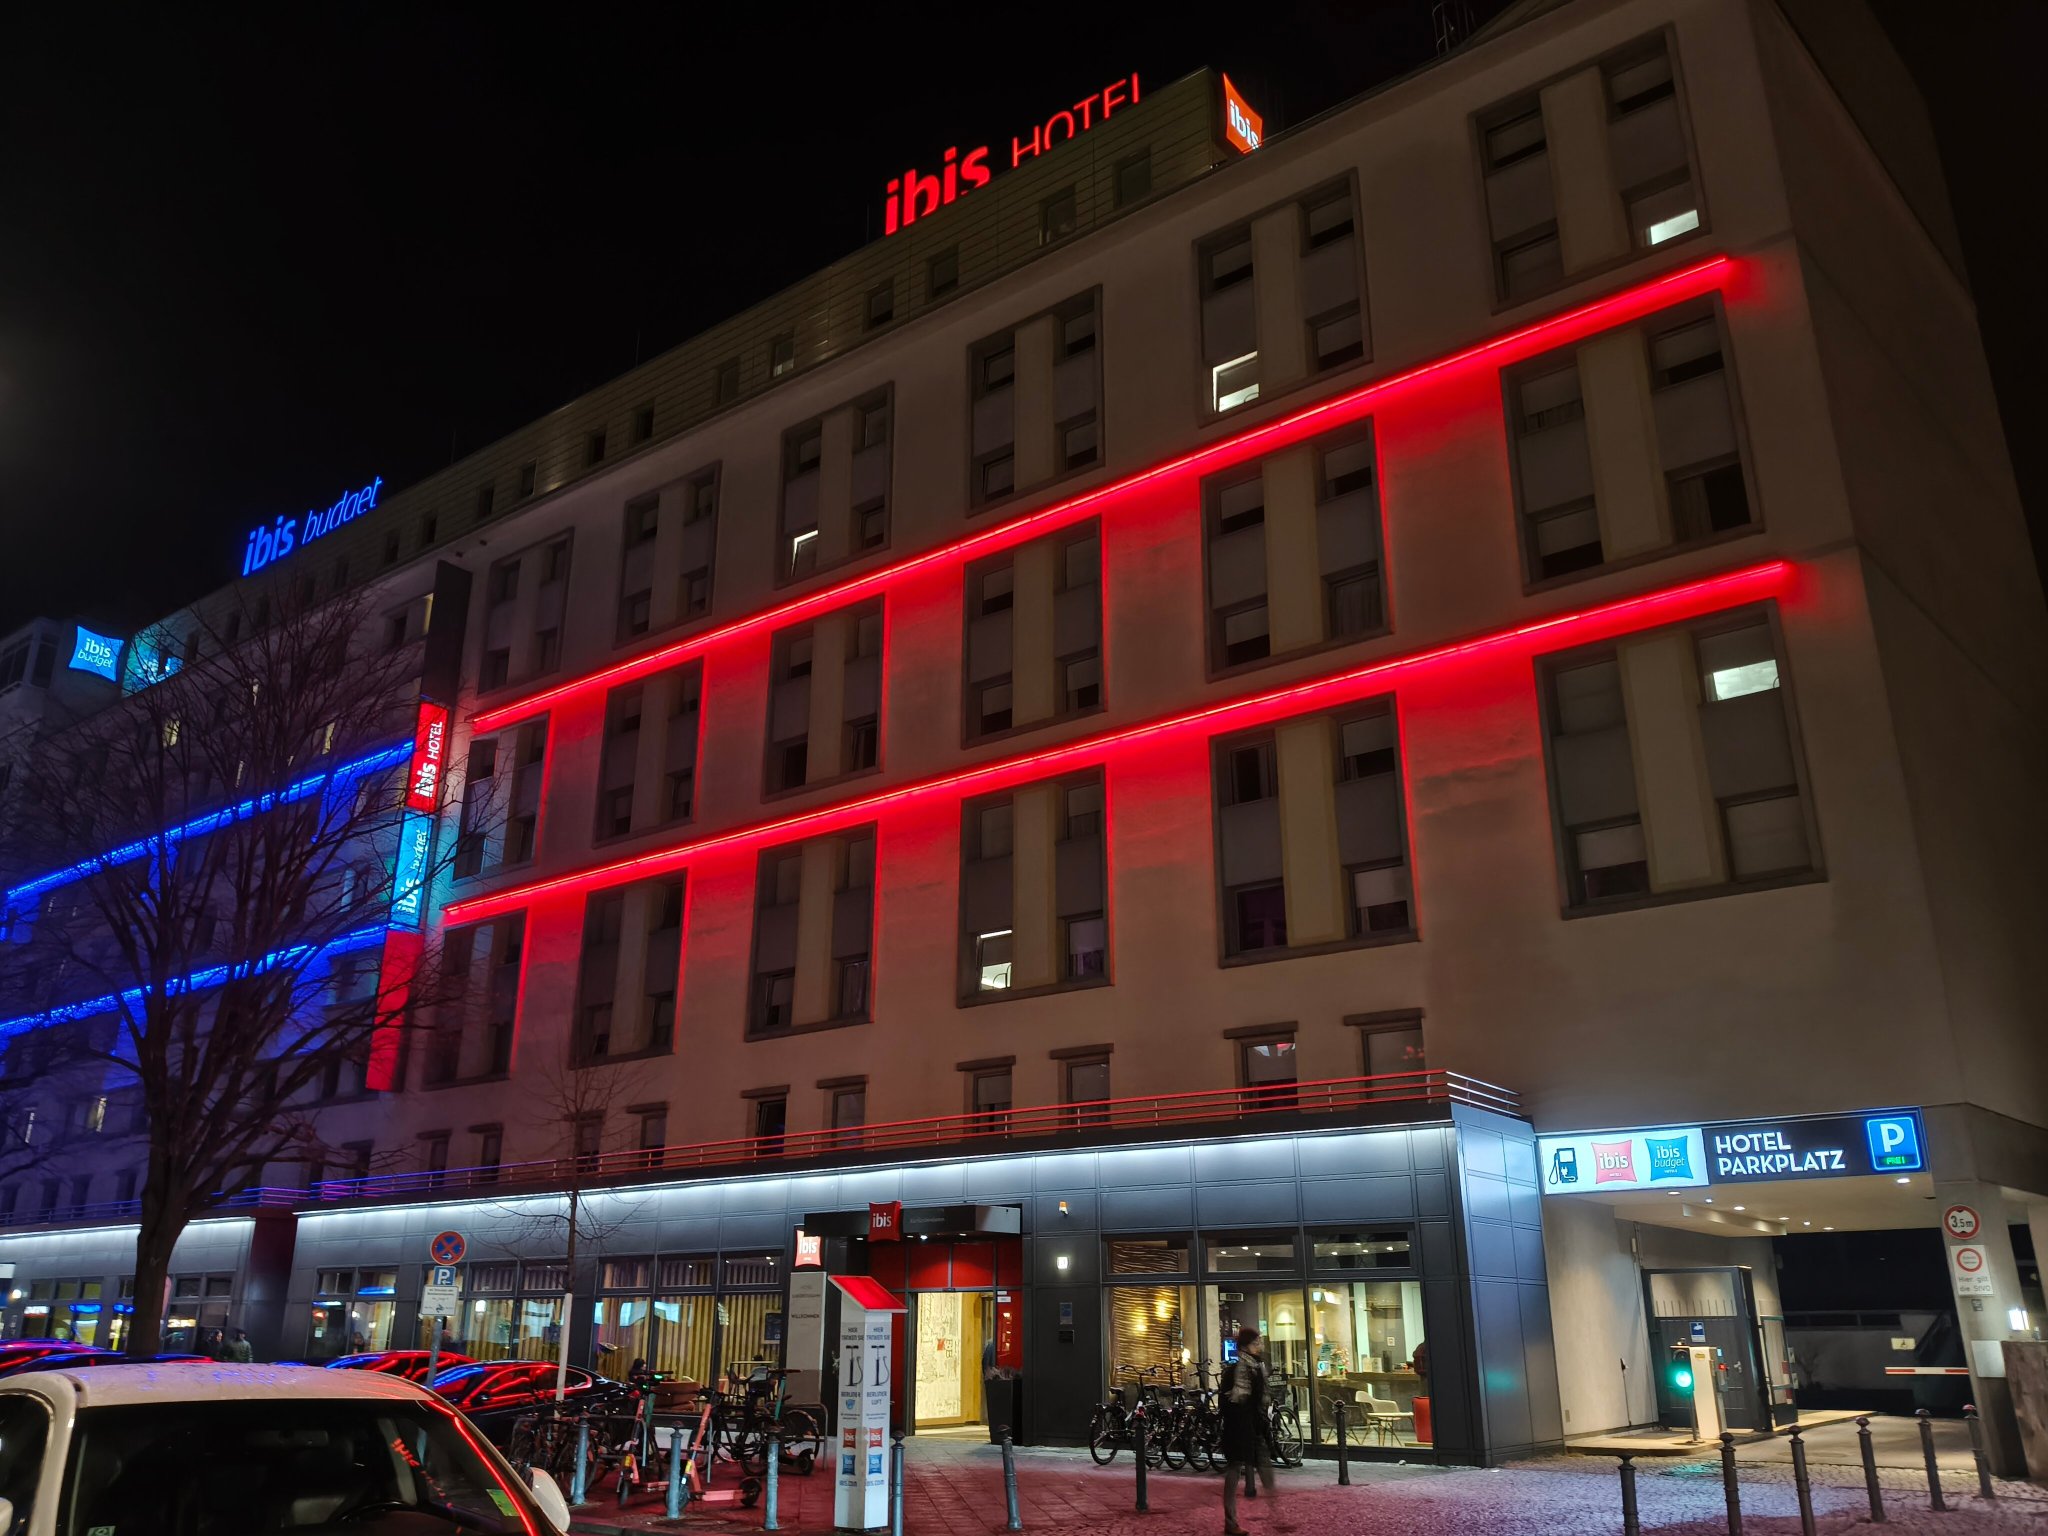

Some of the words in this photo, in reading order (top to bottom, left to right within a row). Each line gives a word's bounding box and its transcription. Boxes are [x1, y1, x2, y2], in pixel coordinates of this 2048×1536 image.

[1229, 98, 1260, 150] ibis
[885, 145, 990, 236] ibis
[242, 515, 296, 576] ibis
[77, 649, 113, 668] budget
[85, 638, 112, 658] ibis
[414, 762, 437, 798] ibis
[427, 721, 443, 760] HOTEL
[397, 877, 419, 914] ibis
[1715, 1131, 1791, 1154] HOTEL
[1879, 1123, 1905, 1153] P
[1599, 1152, 1629, 1169] ibis
[1654, 1156, 1685, 1169] budget
[1656, 1145, 1681, 1159] ibis
[1718, 1149, 1846, 1176] PARKPLATZ
[872, 1212, 892, 1228] ibis
[799, 1238, 818, 1254] ibis
[437, 1268, 451, 1285] P
